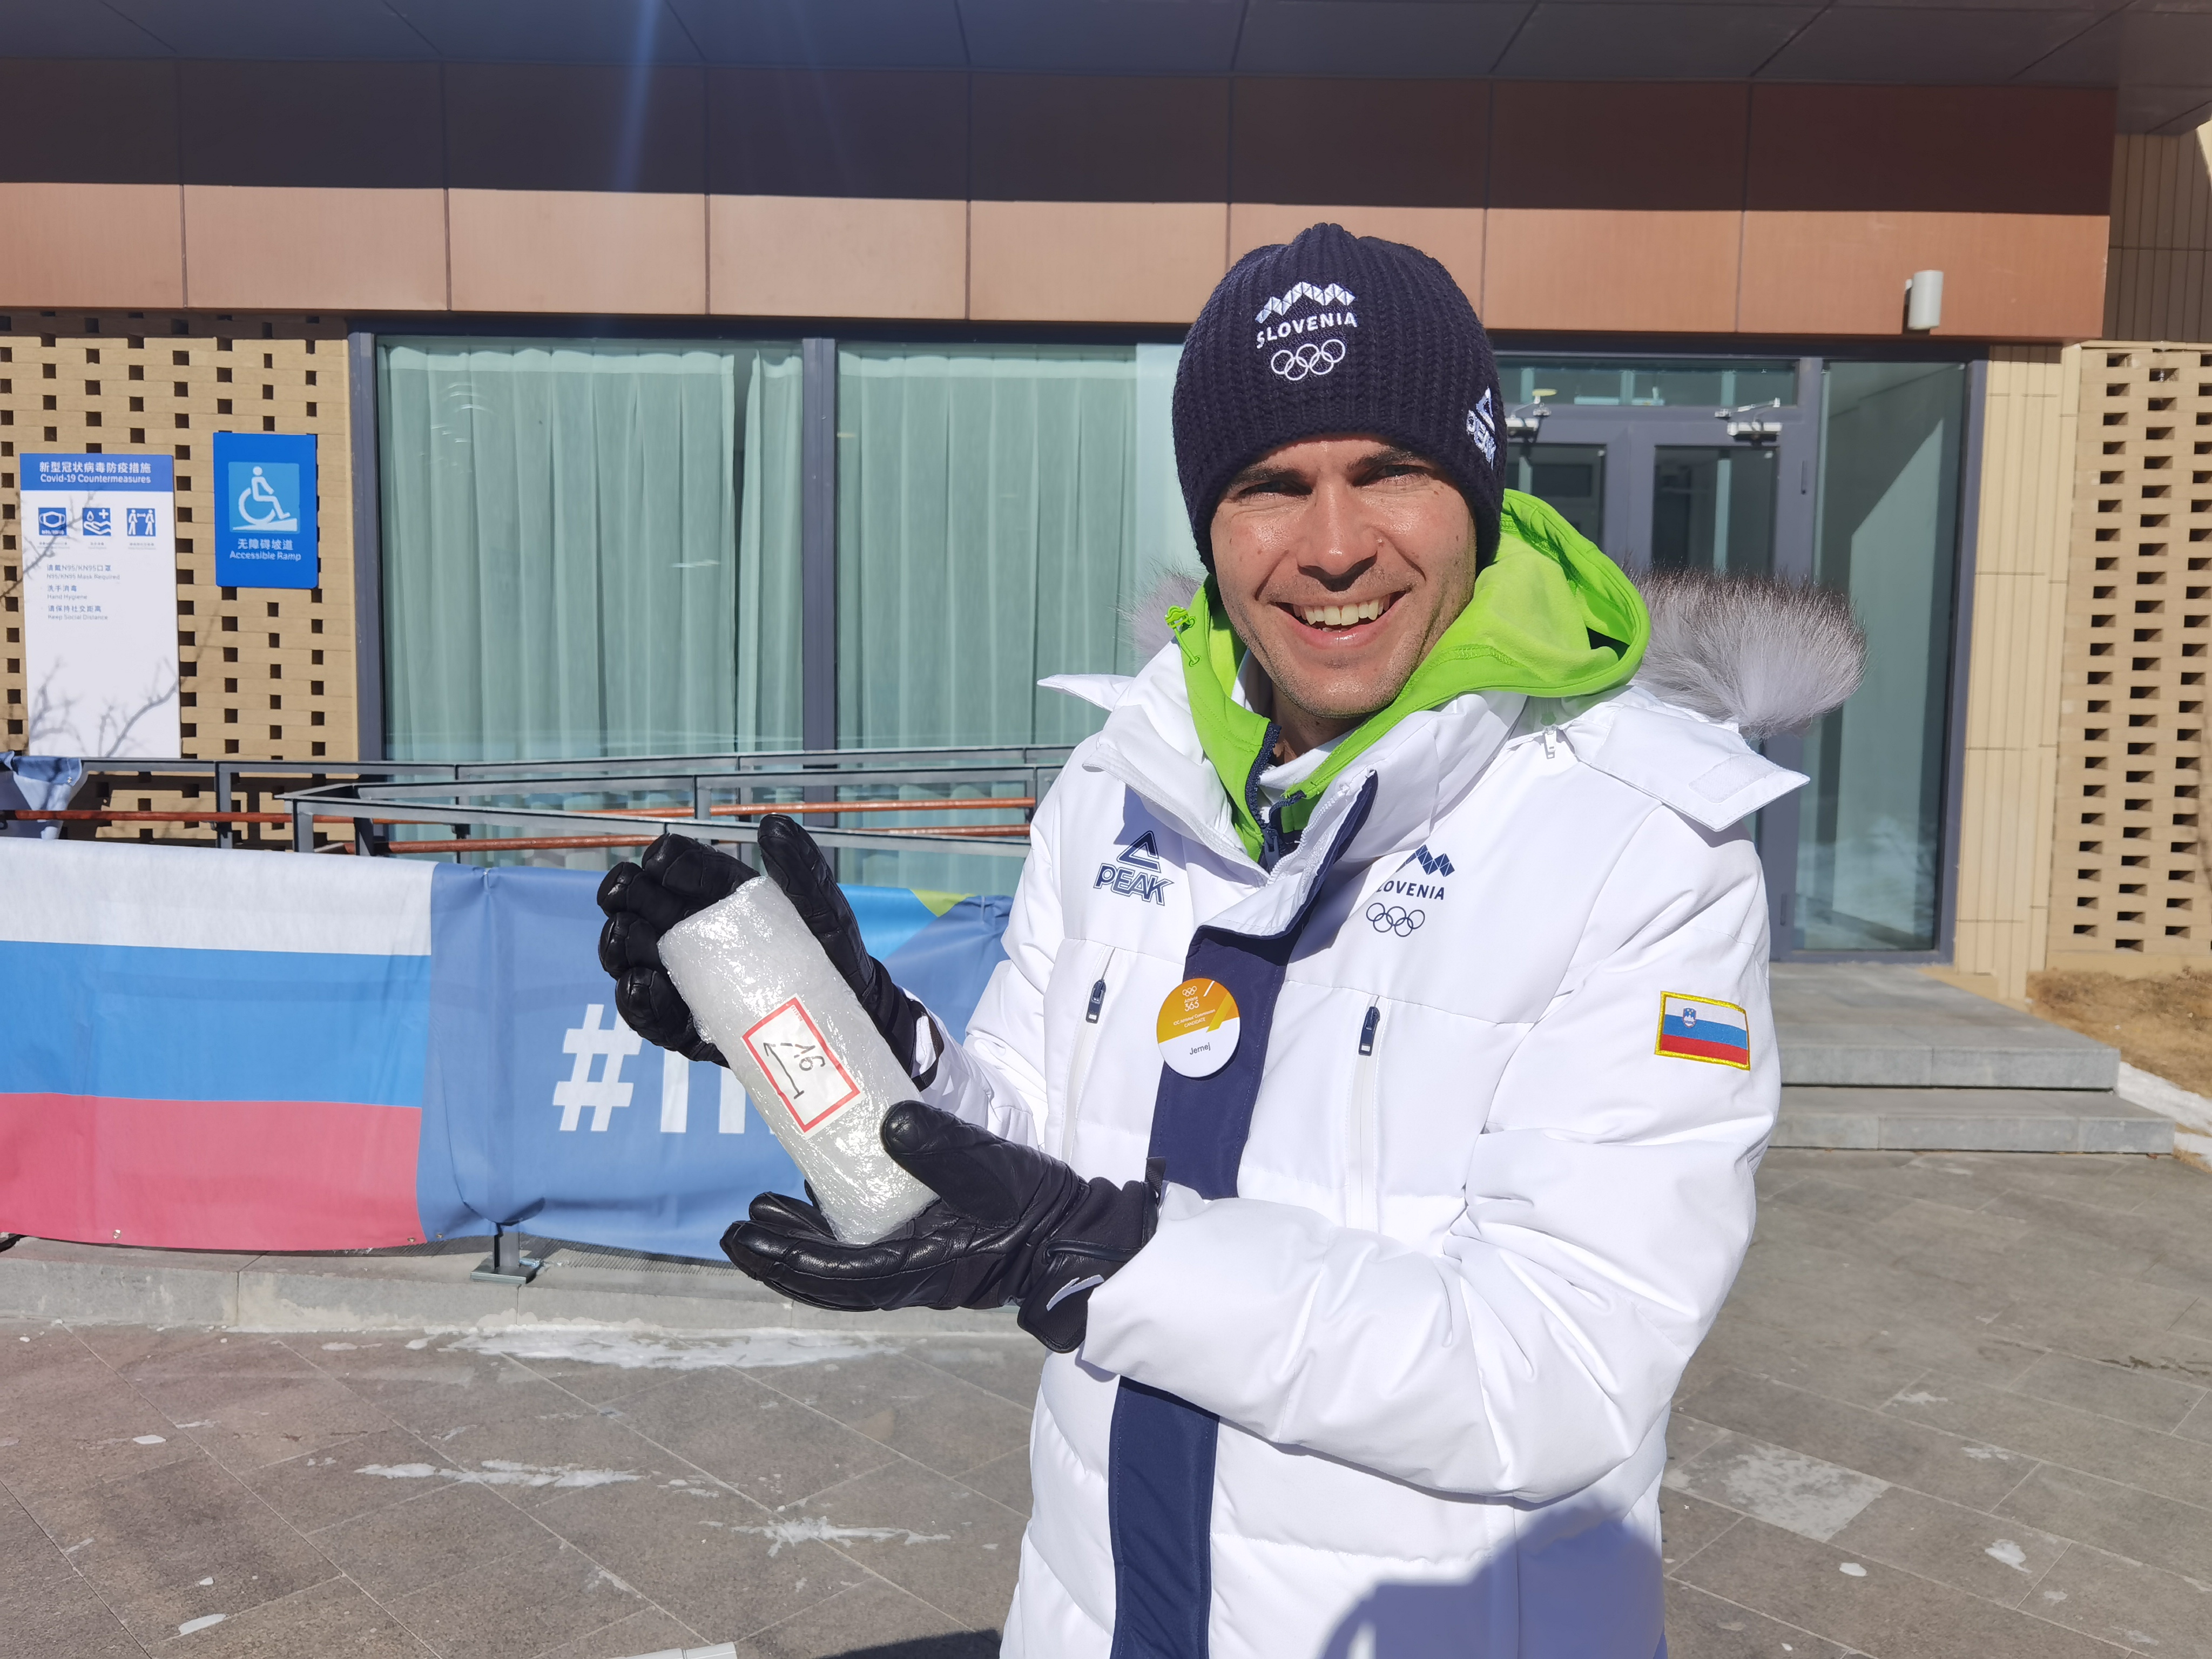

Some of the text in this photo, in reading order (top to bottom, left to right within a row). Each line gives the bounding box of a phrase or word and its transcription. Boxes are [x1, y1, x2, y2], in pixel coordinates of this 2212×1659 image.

[1256, 312, 1358, 349] SLOVENIA
[39, 461, 151, 474] 新型冠状病毒防疫措施
[41, 474, 151, 483] Covid-19 Countermeasures
[238, 538, 293, 550] 无障碍坡道
[230, 550, 301, 562] Accessible Ramp
[1093, 862, 1175, 907] PEAK
[1184, 1000, 1199, 1011] 365
[1184, 1017, 1206, 1028] CANDIDATE
[1189, 1042, 1211, 1055] Jernej
